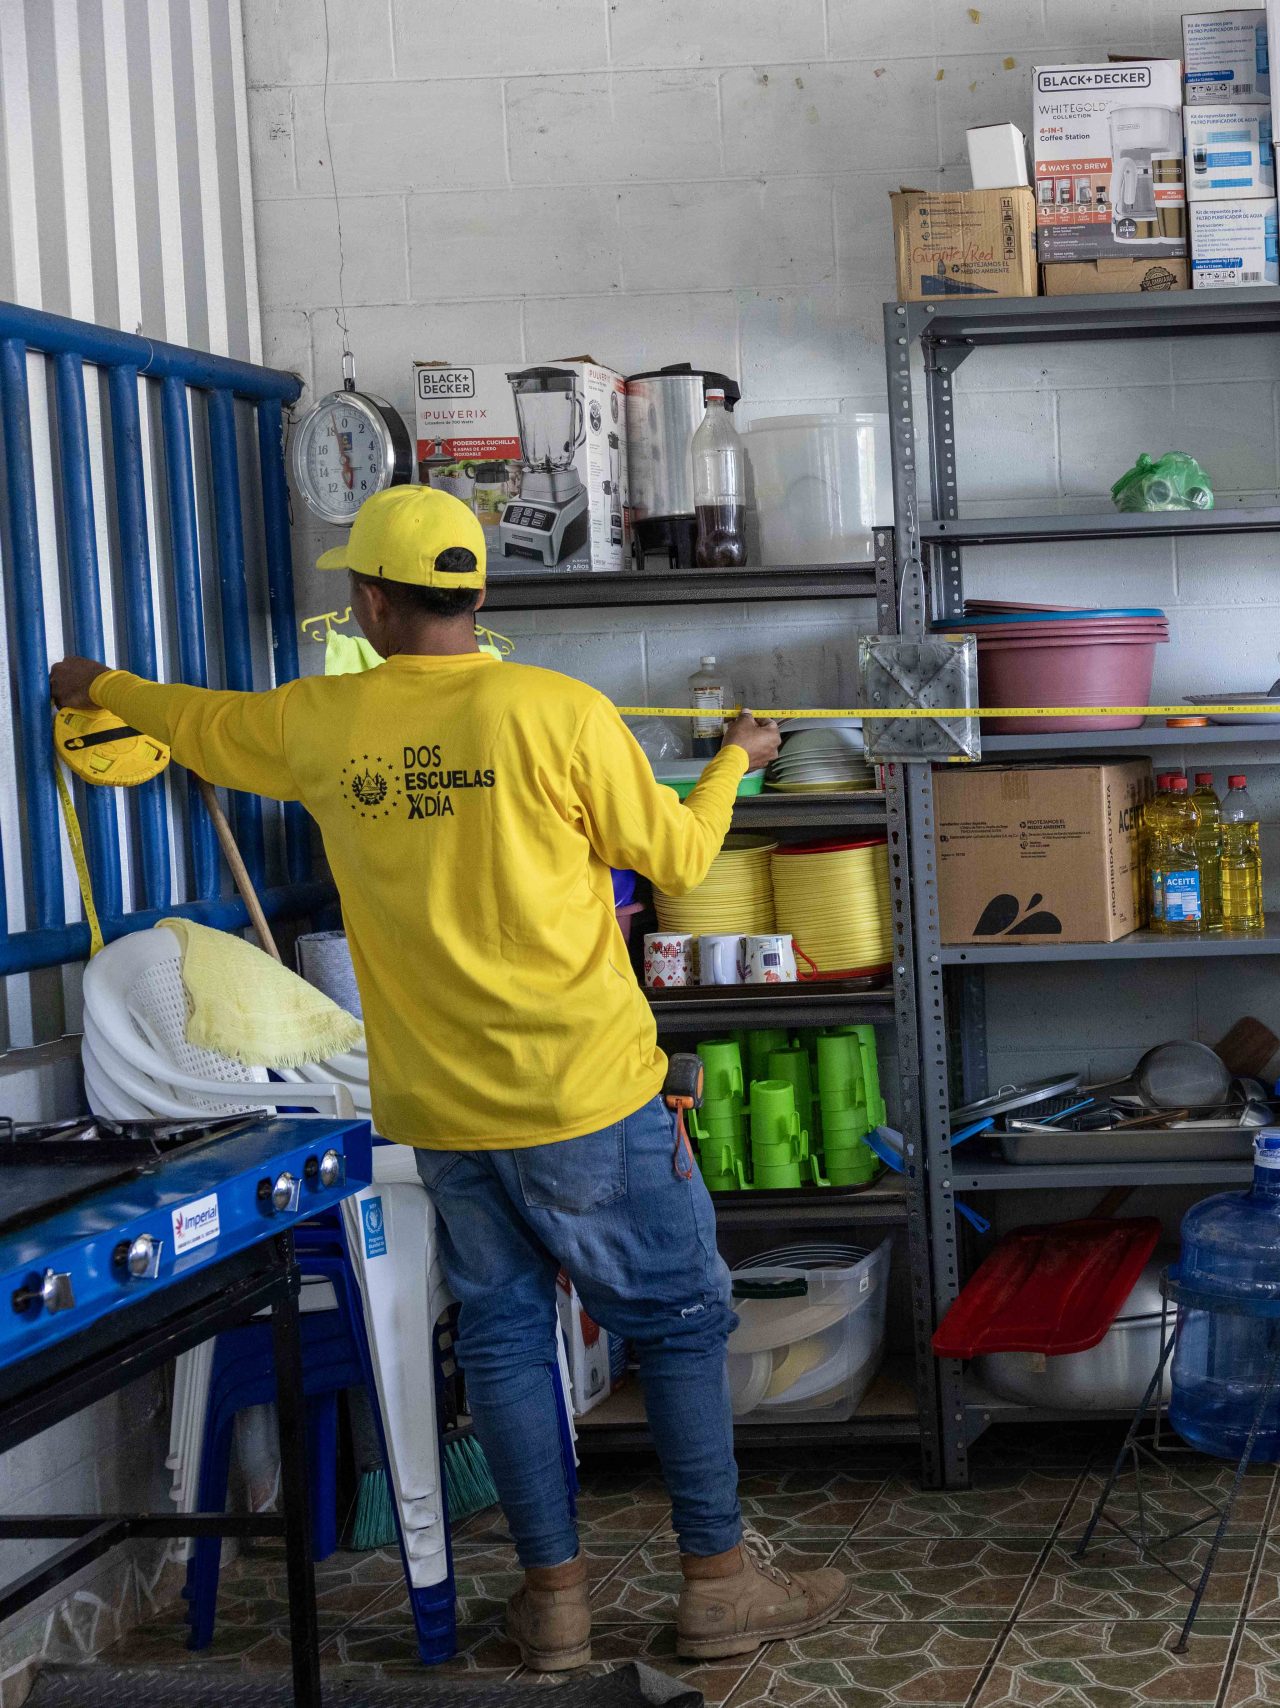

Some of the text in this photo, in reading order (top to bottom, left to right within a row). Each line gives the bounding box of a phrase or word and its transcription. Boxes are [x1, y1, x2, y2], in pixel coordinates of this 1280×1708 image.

[1043, 72, 1145, 87] BLACK+DECKER
[1039, 103, 1105, 115] WHITEGOLD
[1040, 134, 1063, 142] Coffee
[1040, 164, 1047, 172] 4
[423, 374, 469, 384] BLACK+
[424, 384, 470, 394] DECKER
[425, 410, 487, 420] PULVERIX
[327, 426, 336, 437] 18
[318, 445, 328, 455] 16
[319, 468, 329, 478] 14
[328, 483, 338, 493] 12
[343, 492, 354, 502] 10
[403, 744, 442, 769] DOS
[404, 769, 495, 791] ESCUELAS
[1108, 828, 1113, 844] SU
[185, 1204, 217, 1230] Imperial
